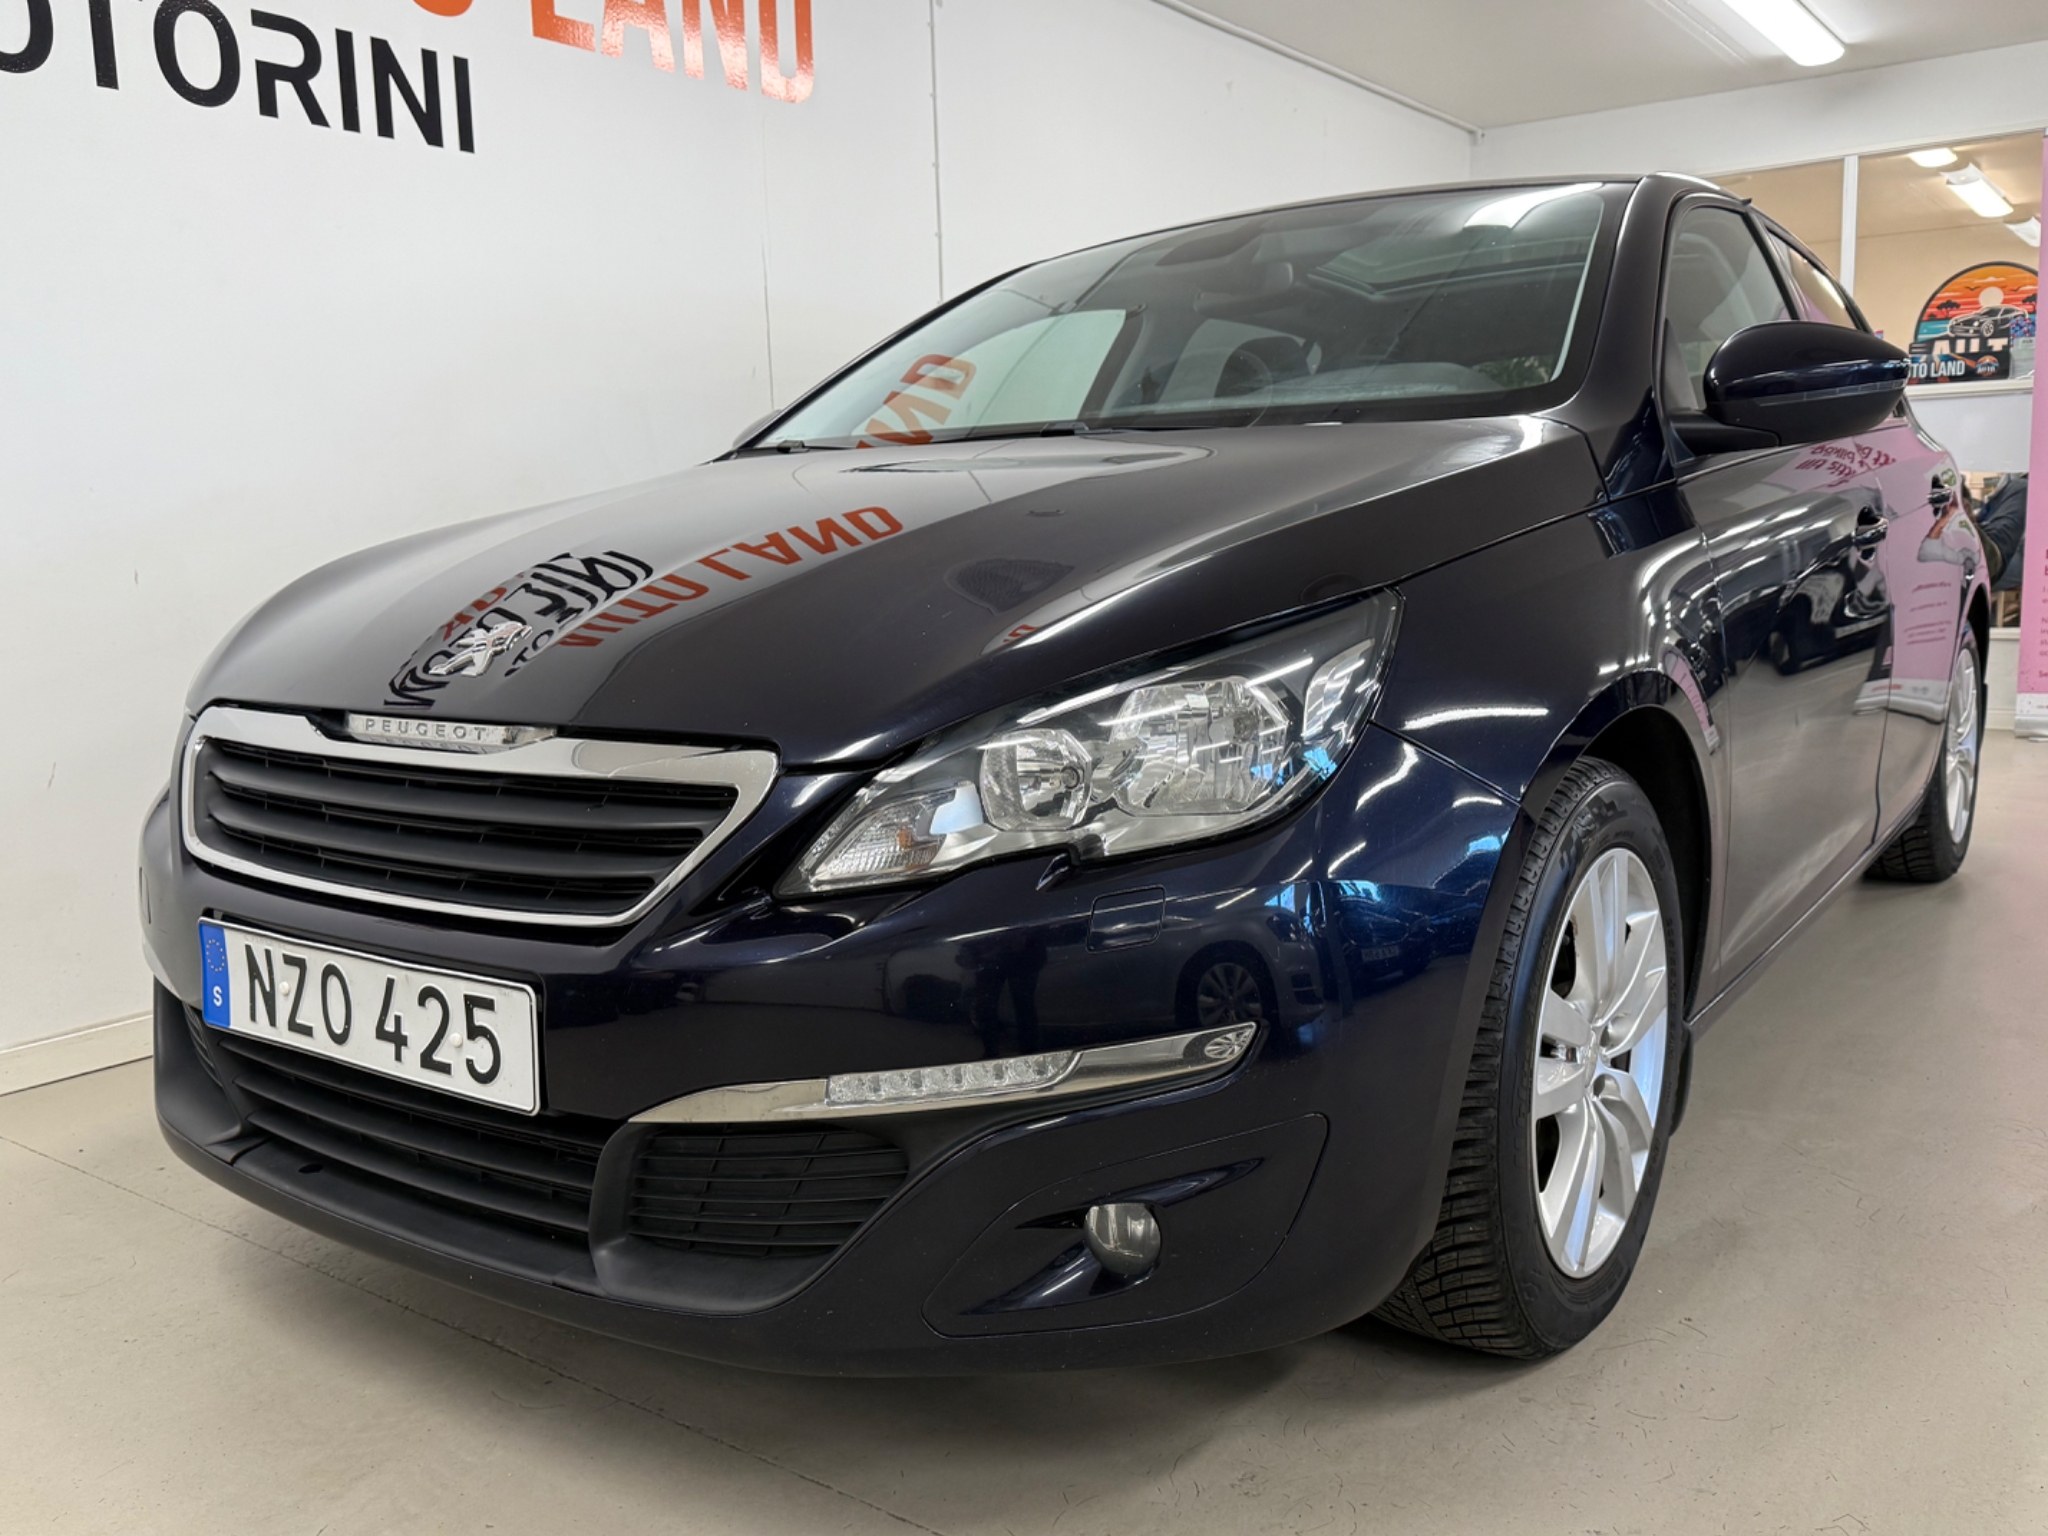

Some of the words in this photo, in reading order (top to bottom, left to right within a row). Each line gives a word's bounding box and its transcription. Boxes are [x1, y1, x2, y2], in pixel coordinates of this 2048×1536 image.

[1930, 360, 1966, 378] LAND
[365, 718, 487, 741] PEUGEOT
[212, 986, 223, 1007] S
[244, 943, 352, 1046] NZO
[375, 976, 502, 1085] 425
